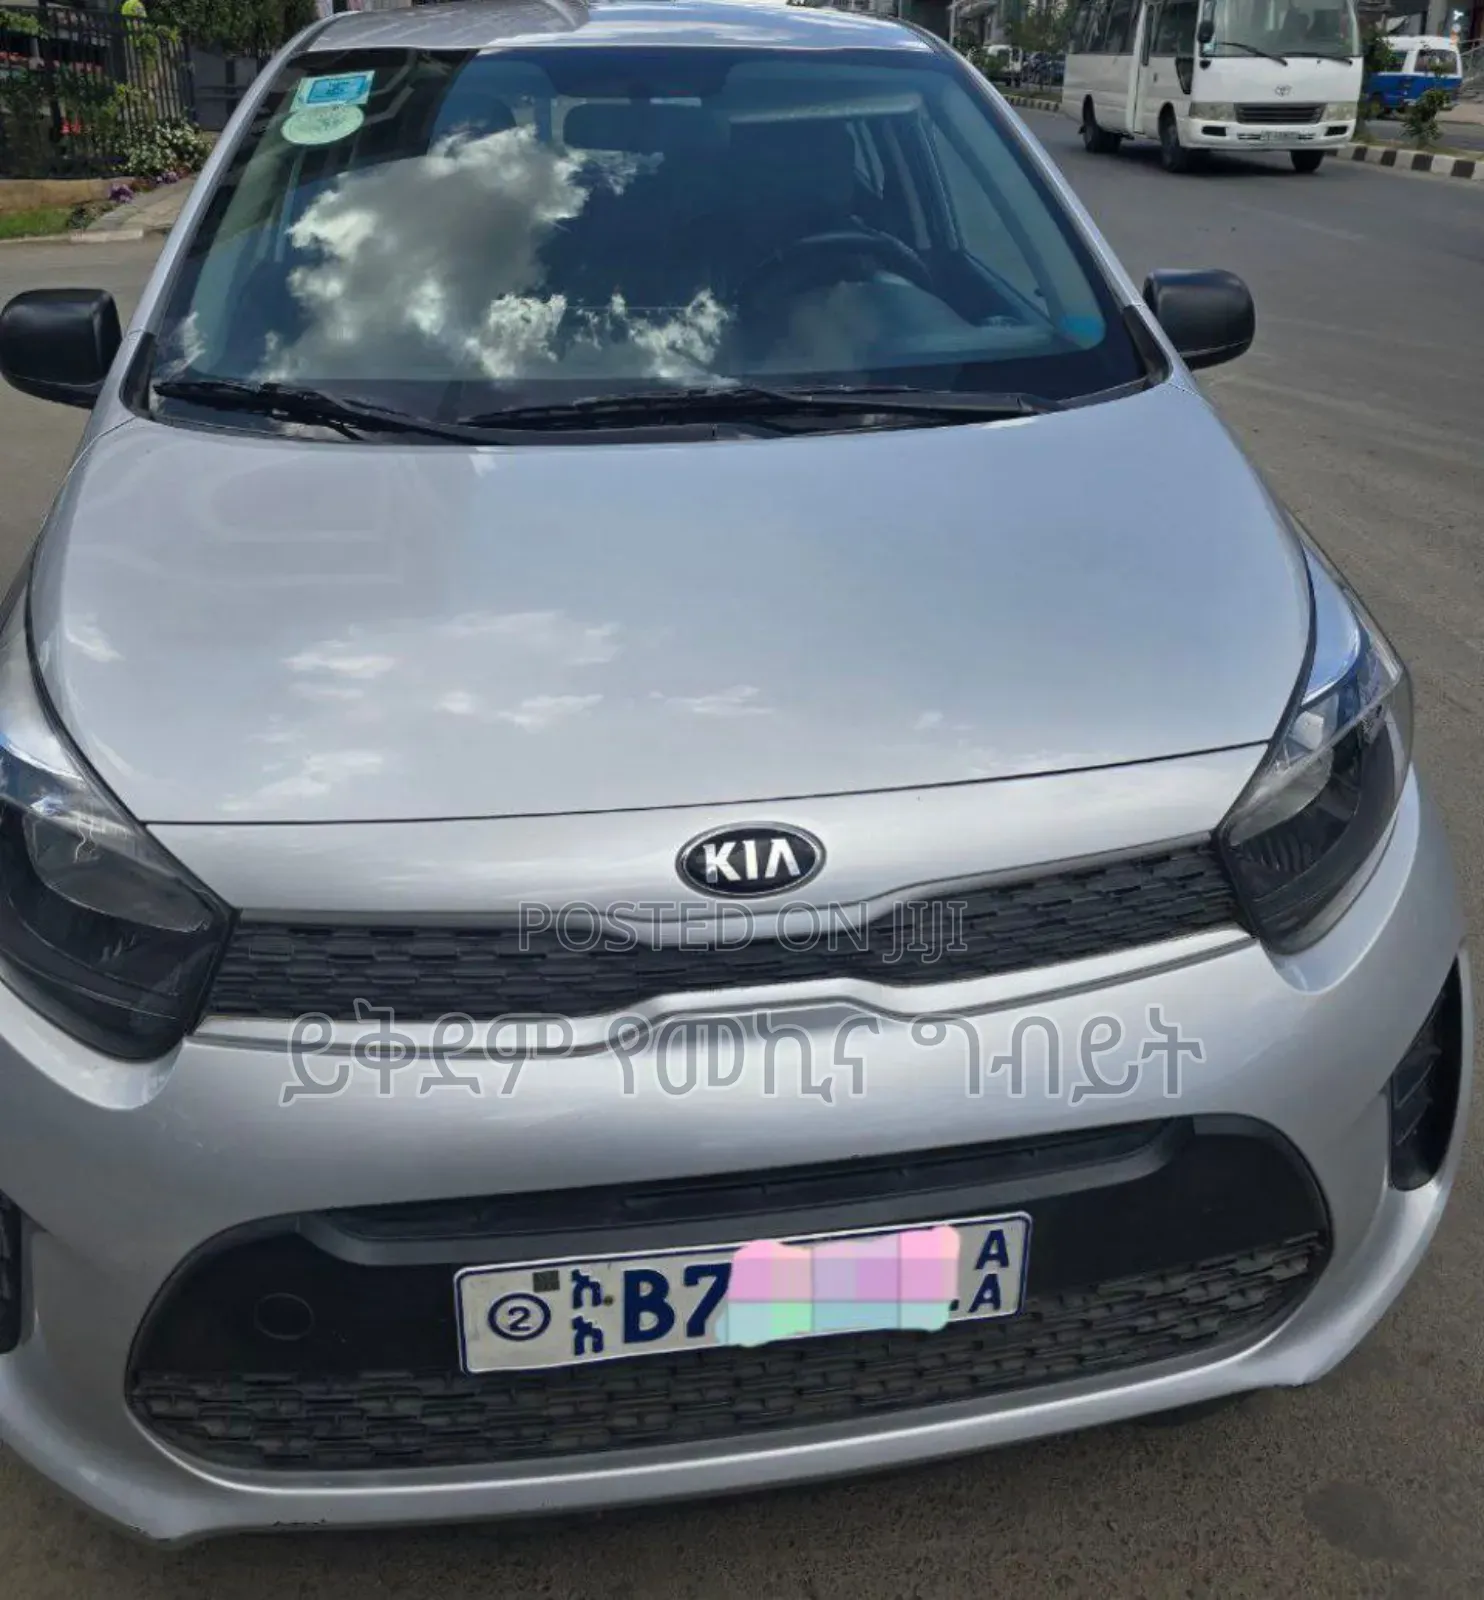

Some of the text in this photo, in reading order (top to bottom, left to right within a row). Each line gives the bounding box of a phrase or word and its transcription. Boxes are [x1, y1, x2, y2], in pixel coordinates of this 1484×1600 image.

[702, 838, 801, 884] KIA
[974, 1229, 1009, 1270] A
[968, 1273, 1001, 1313] A
